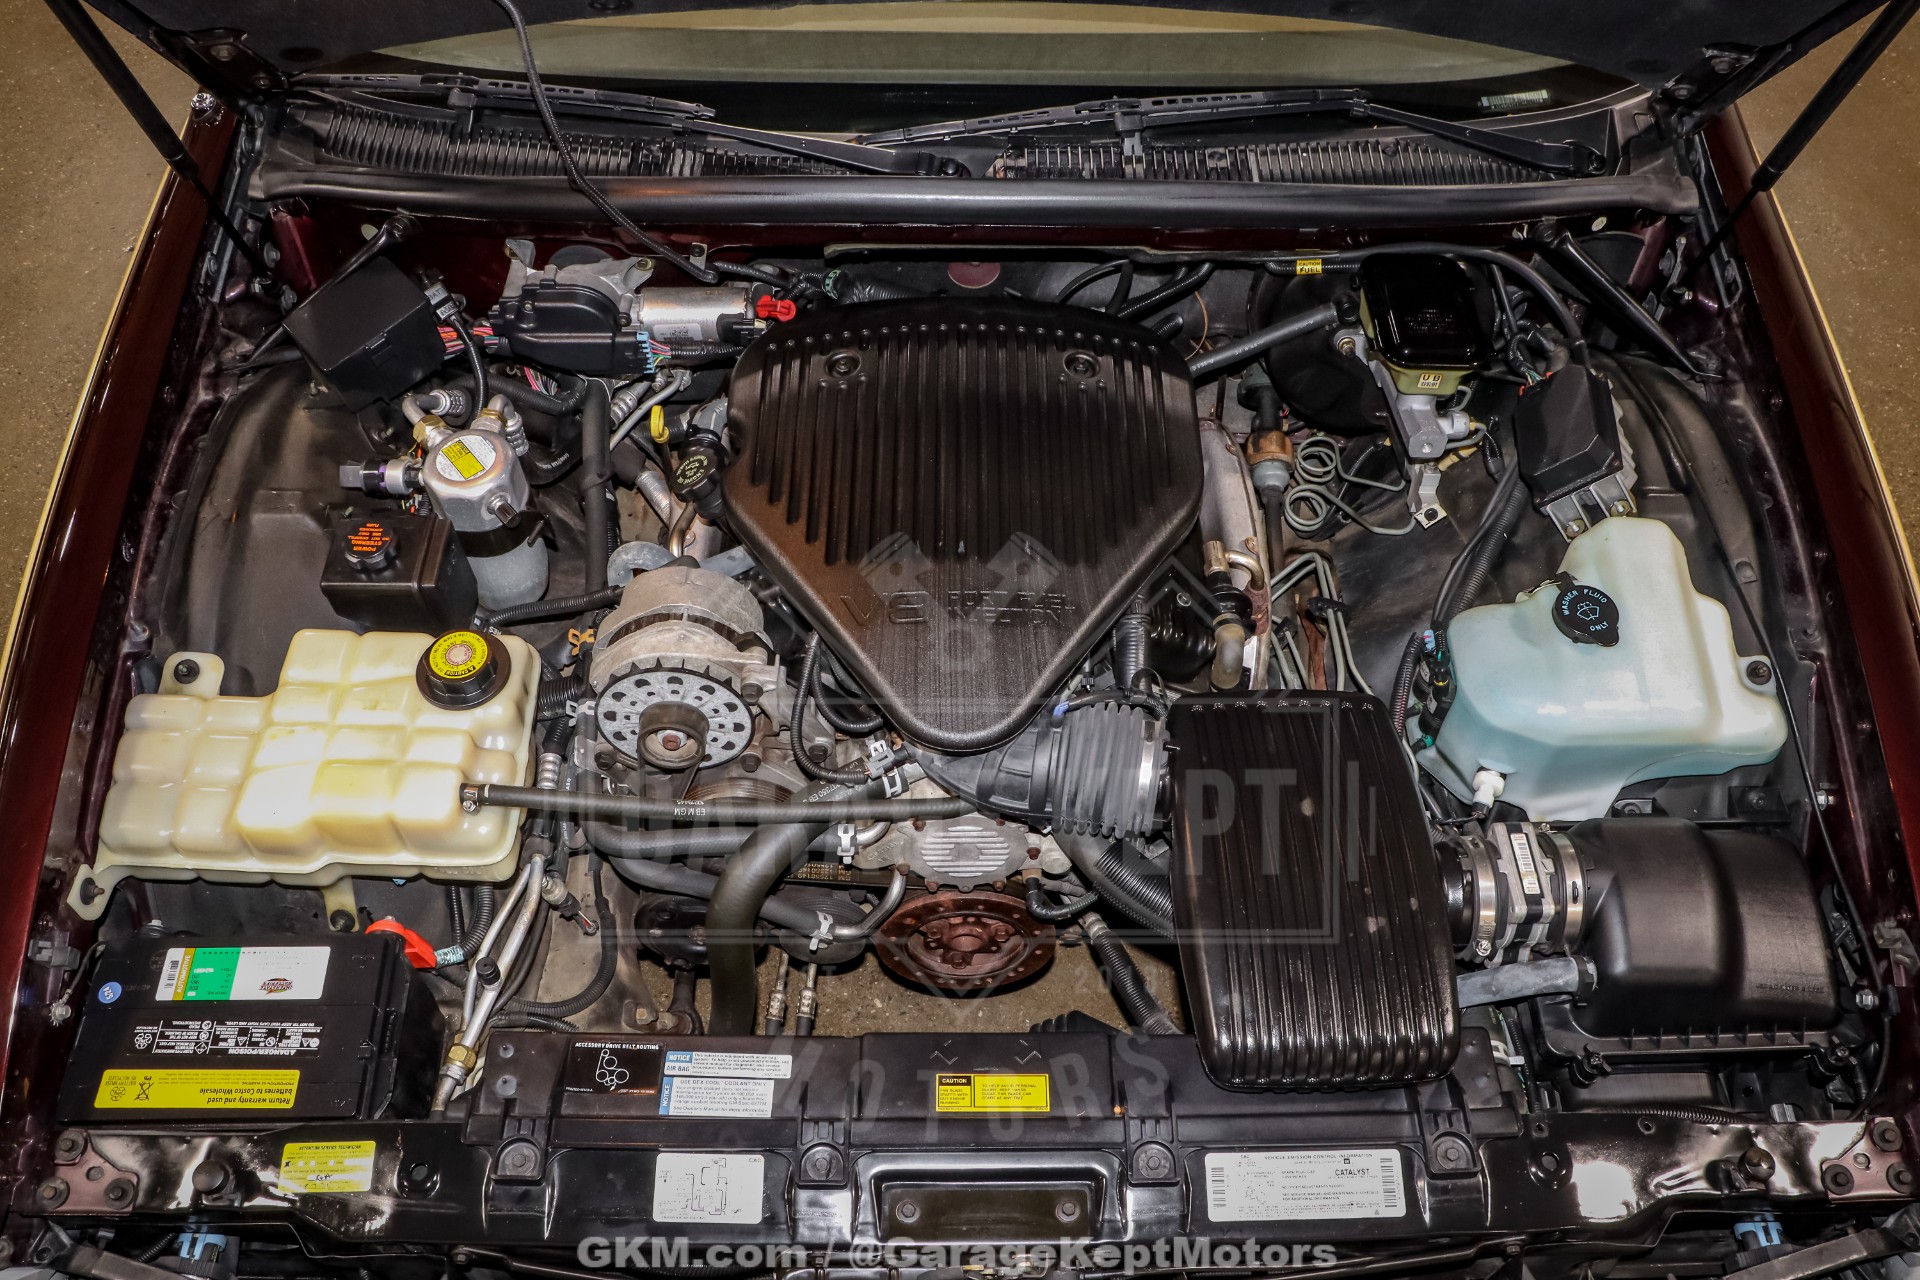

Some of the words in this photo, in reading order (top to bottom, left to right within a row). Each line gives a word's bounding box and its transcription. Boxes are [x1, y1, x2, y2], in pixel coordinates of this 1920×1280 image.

[1562, 590, 1579, 616] WASHER
[1583, 588, 1608, 603] FLUID
[1590, 620, 1609, 631] ONLY
[446, 668, 469, 676] CAUTION
[176, 954, 192, 993] AUTOMOTIVE
[200, 1088, 233, 1096] Wholesale
[234, 1088, 255, 1096] Costco
[264, 1088, 293, 1096] batteries
[662, 1084, 671, 1107] NOTICE
[207, 1097, 223, 1105] used
[224, 1097, 237, 1105] and
[238, 1096, 267, 1104] warranty
[268, 1097, 291, 1105] Return
[1334, 1168, 1370, 1176] CATALYST
